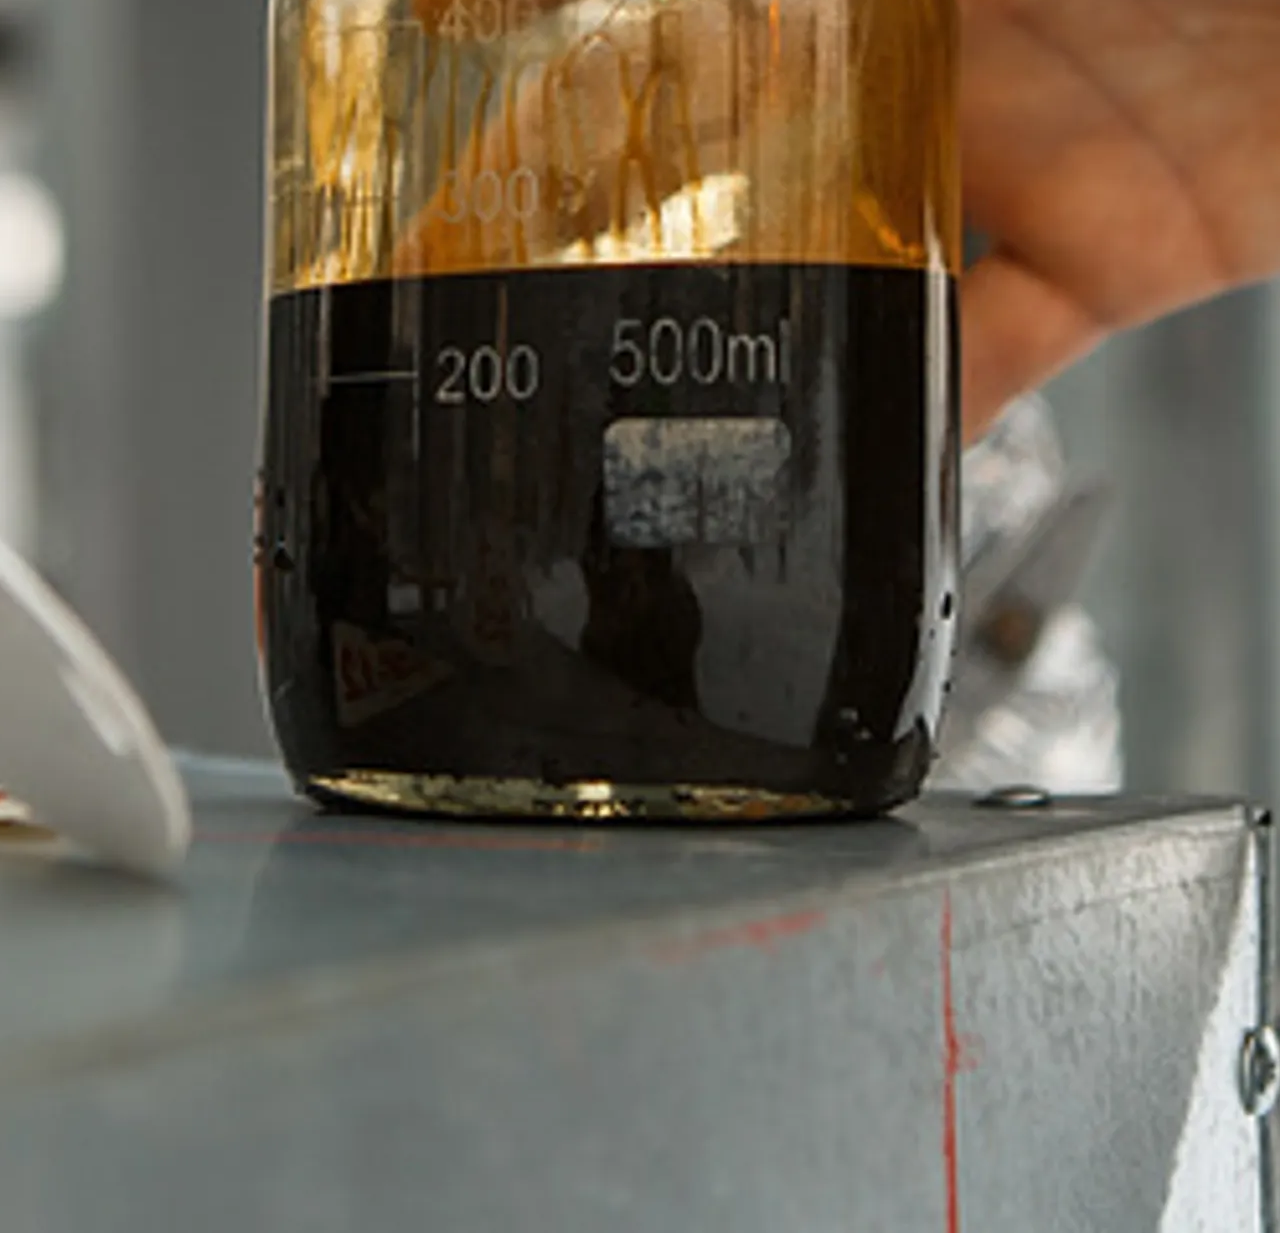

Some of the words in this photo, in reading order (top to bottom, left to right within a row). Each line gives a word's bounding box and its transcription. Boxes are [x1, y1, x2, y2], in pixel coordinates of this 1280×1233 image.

[436, 169, 539, 223] 300
[435, 346, 539, 403] 200
[608, 317, 792, 387] 500ml
